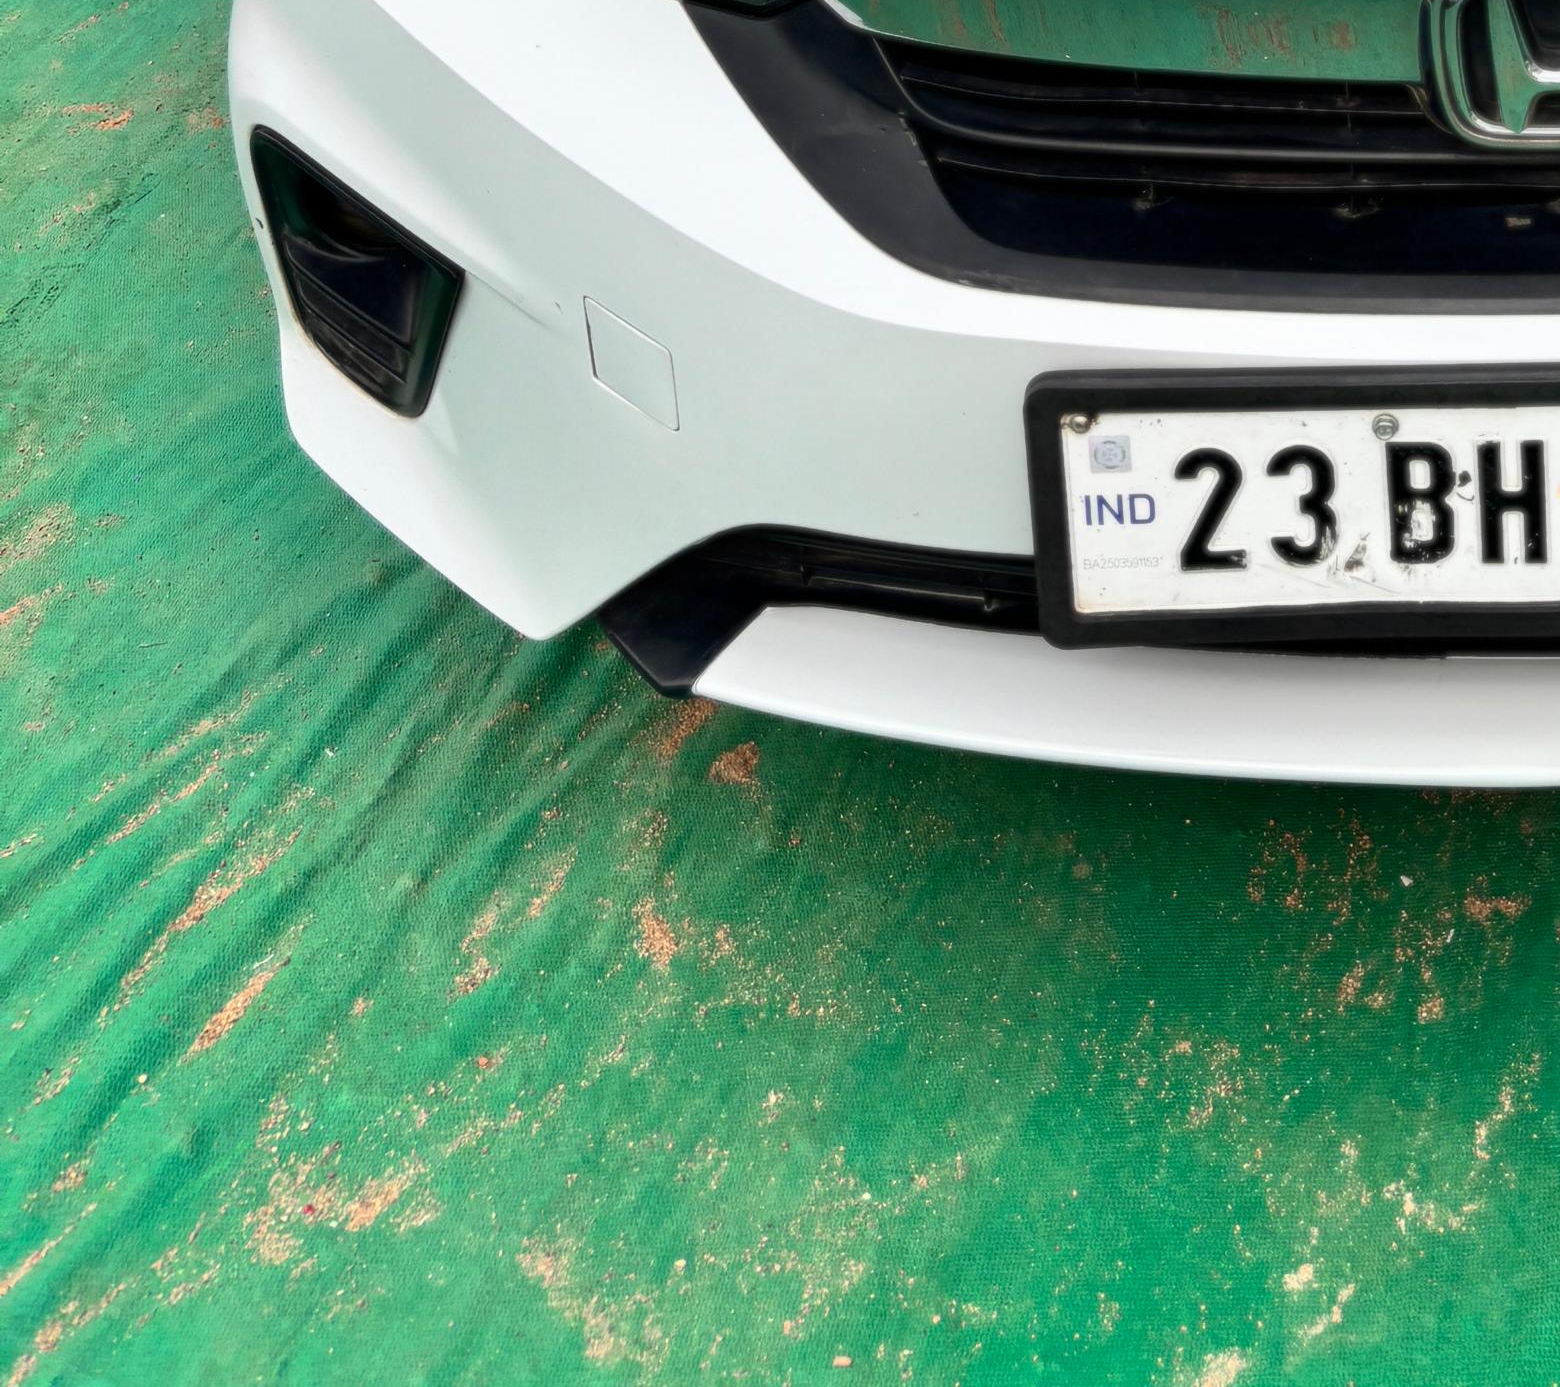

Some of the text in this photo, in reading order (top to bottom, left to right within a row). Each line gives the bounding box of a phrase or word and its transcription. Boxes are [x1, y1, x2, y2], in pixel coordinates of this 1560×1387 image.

[1083, 492, 1157, 527] IND
[1173, 443, 1339, 573] 23
[1383, 439, 1550, 566] BH
